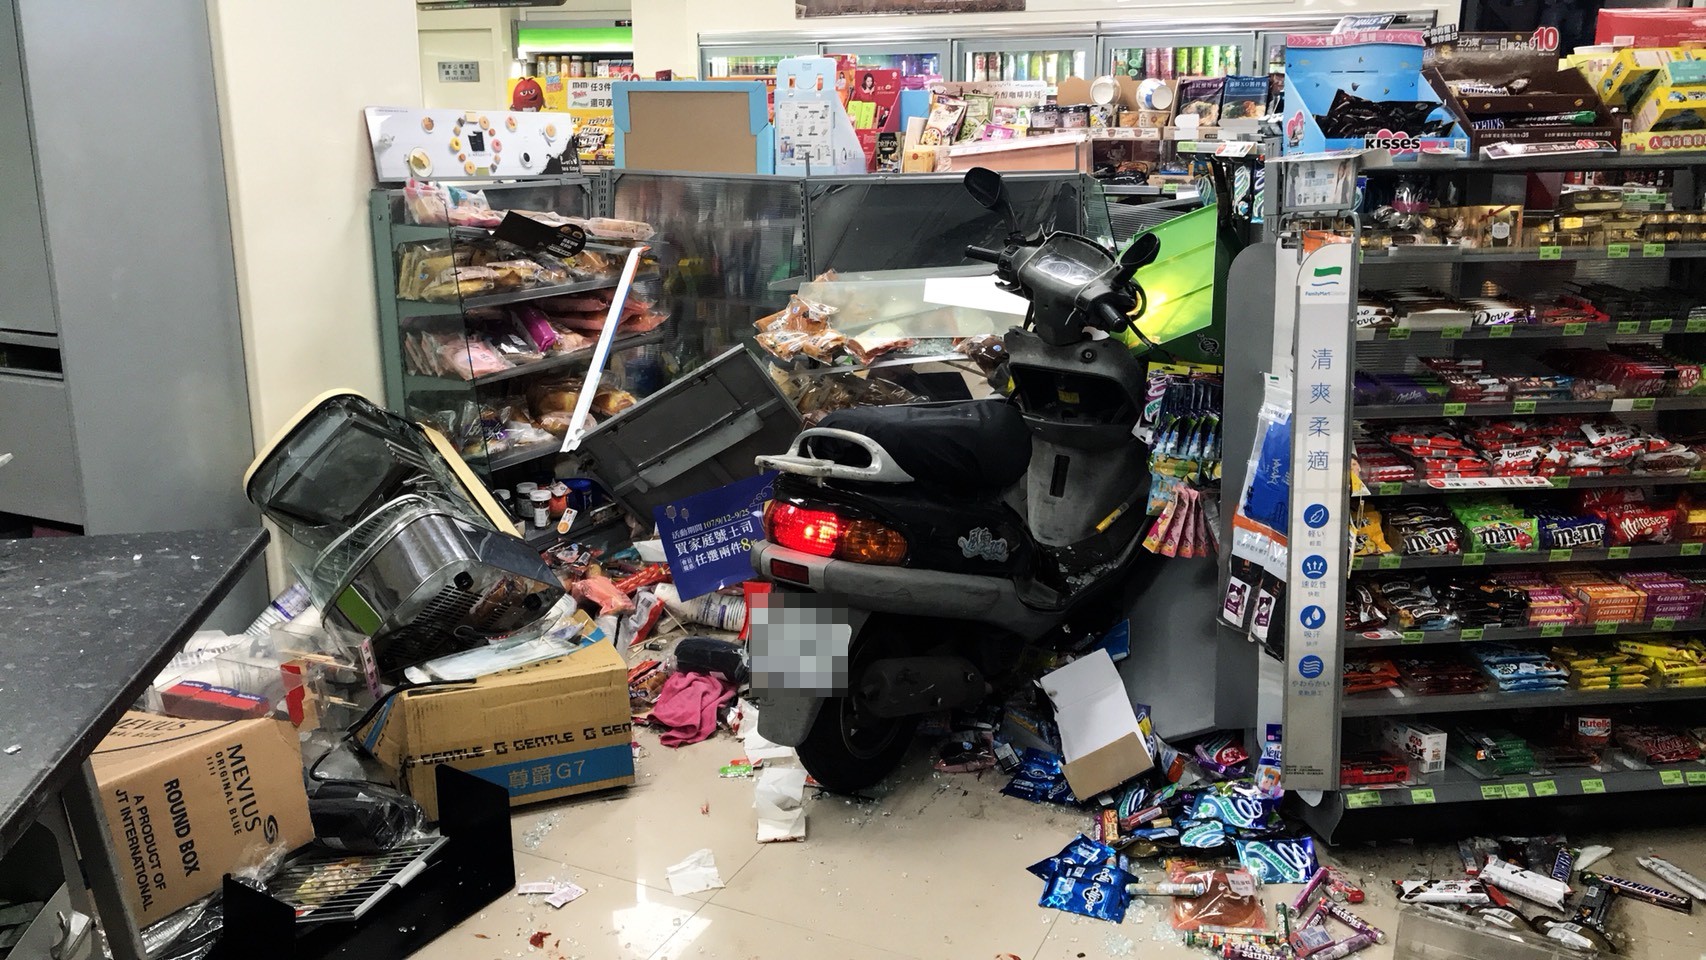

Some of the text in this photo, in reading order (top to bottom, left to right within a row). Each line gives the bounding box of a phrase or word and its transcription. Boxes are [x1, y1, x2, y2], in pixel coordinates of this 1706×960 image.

[590, 83, 611, 92] 任3件
[1356, 317, 1376, 325] ove
[1475, 310, 1510, 325] Dove
[1309, 348, 1333, 471] 清爽柔適
[1506, 448, 1532, 459] bueno
[675, 520, 754, 557] 買家庭號土司
[1621, 515, 1669, 542] Maltesers
[1586, 584, 1629, 592] Gummy
[1642, 582, 1685, 590] Gummy
[1656, 594, 1691, 602] Gummy
[1597, 608, 1631, 616] Gummy
[513, 732, 575, 751] GENTLE
[215, 751, 242, 836] ORIGINAL BLUE
[227, 744, 261, 832] MEVIUS
[164, 778, 200, 877] ROUND BOX
[115, 789, 154, 912] JT INTERNATIONAL
[134, 795, 166, 891] A PRODUCT OF
[1249, 842, 1300, 880] Airwaves
[1085, 882, 1101, 913] eclipse
